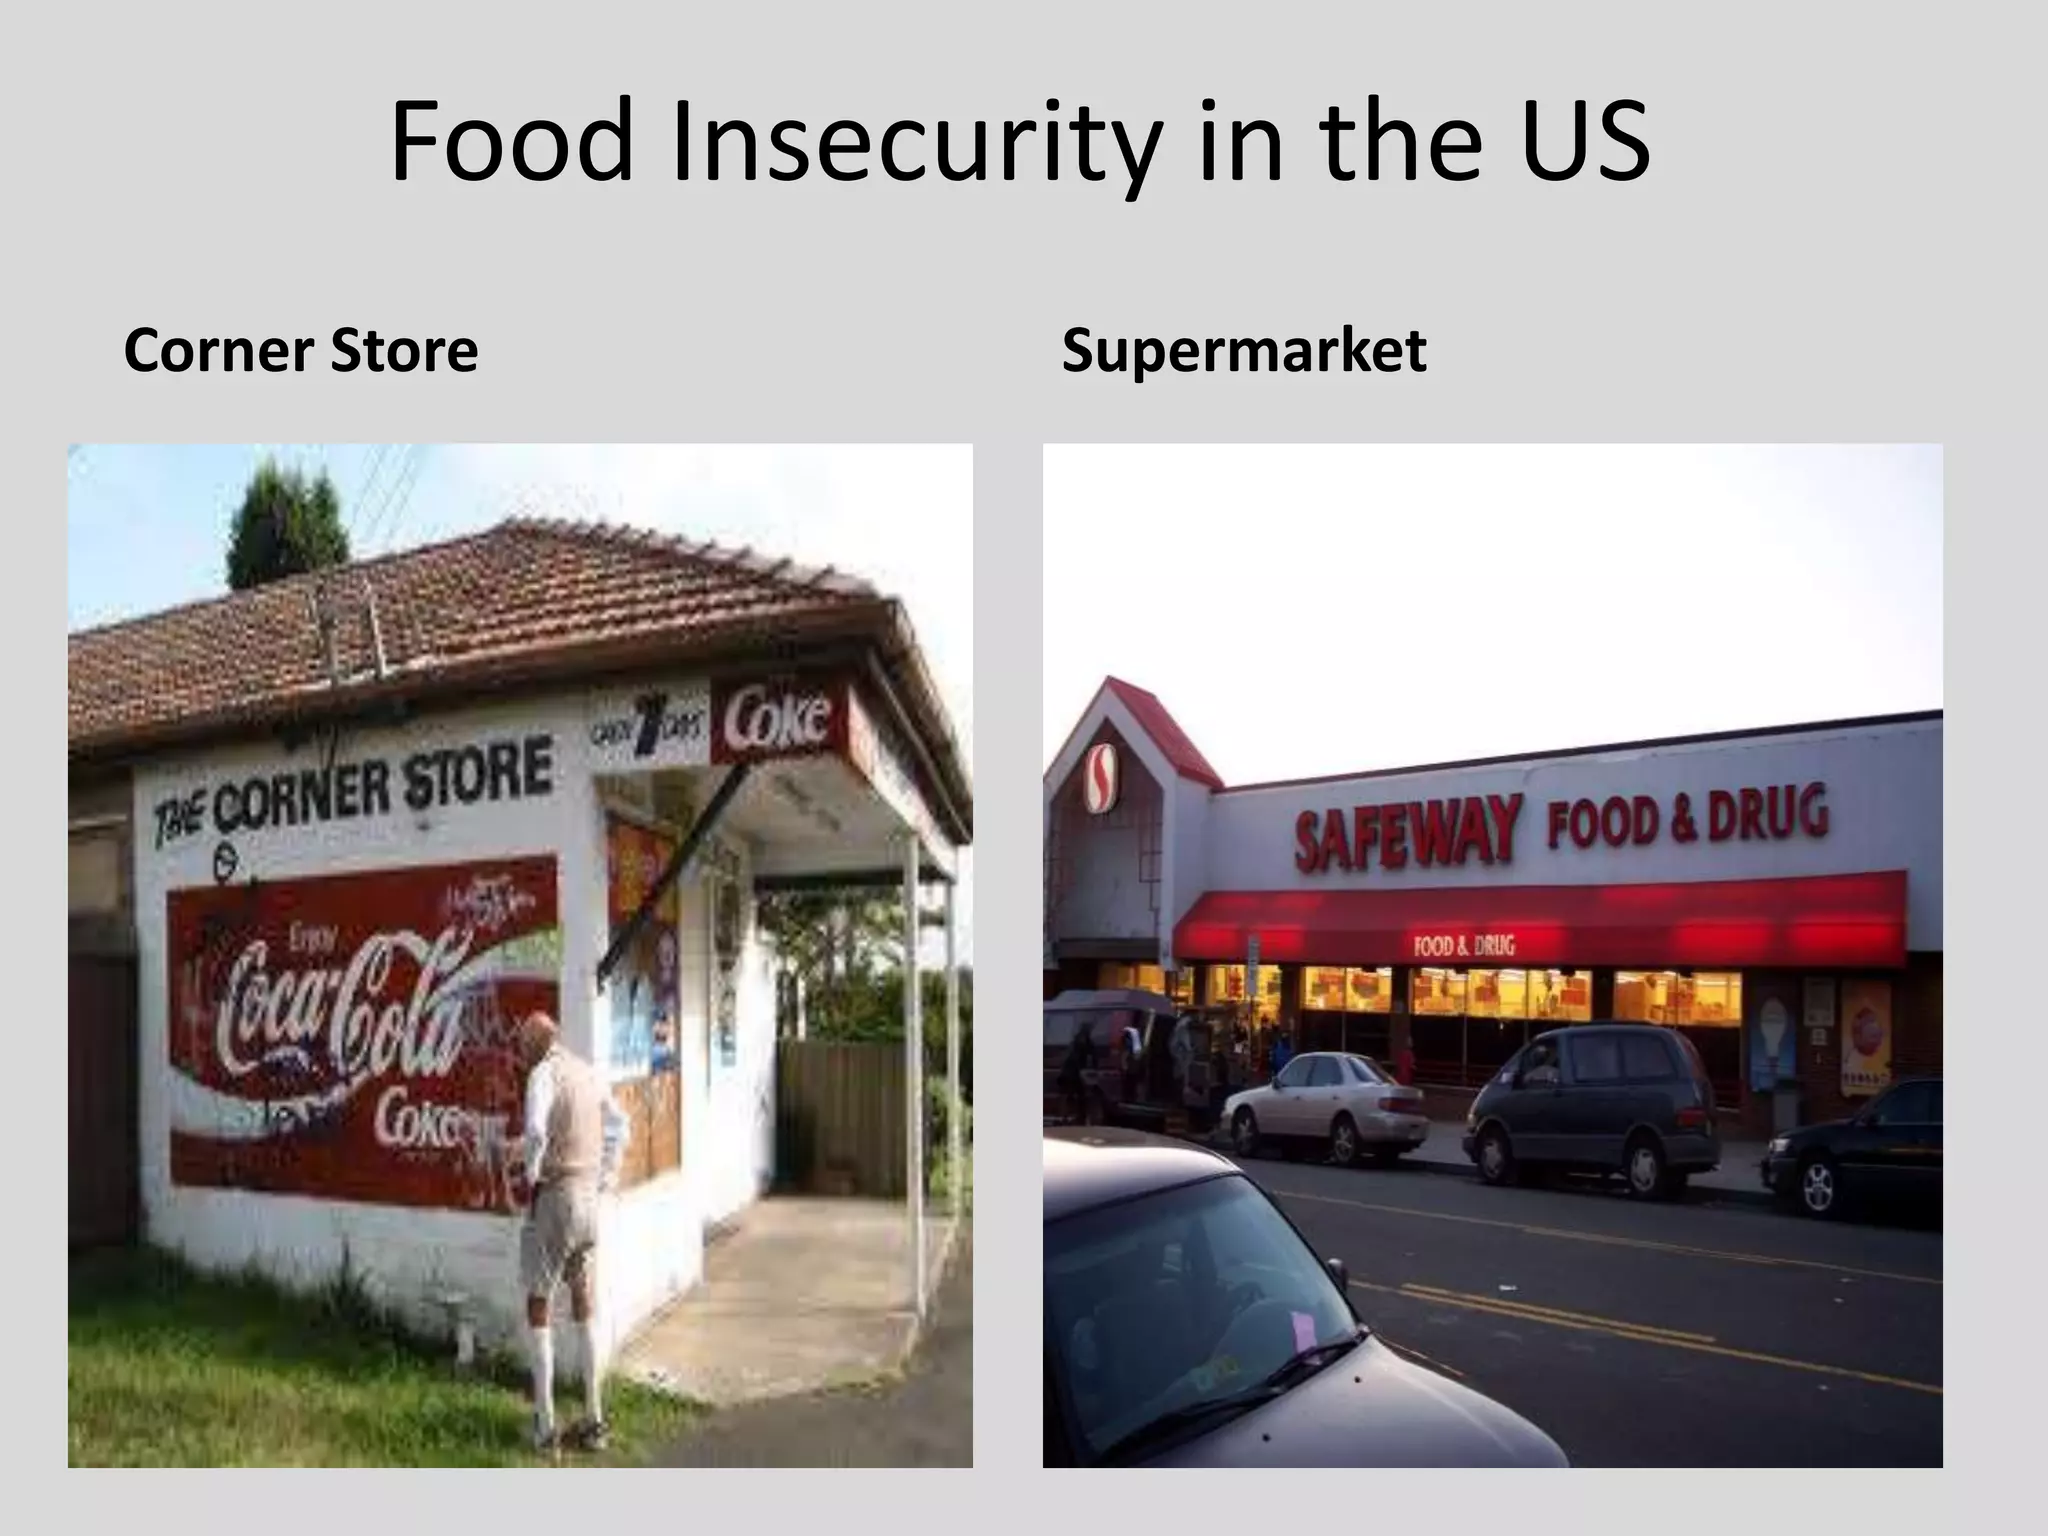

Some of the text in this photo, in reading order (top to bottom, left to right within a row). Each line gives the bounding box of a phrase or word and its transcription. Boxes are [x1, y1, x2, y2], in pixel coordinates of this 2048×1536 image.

[724, 683, 831, 750] Coke
[154, 734, 554, 850] THE CORNER STORE
[1294, 780, 1830, 876] SAFEWAY FOOD & DRUG
[1414, 934, 1516, 957] FOOD & DRUG
[374, 1085, 460, 1148] Coke
